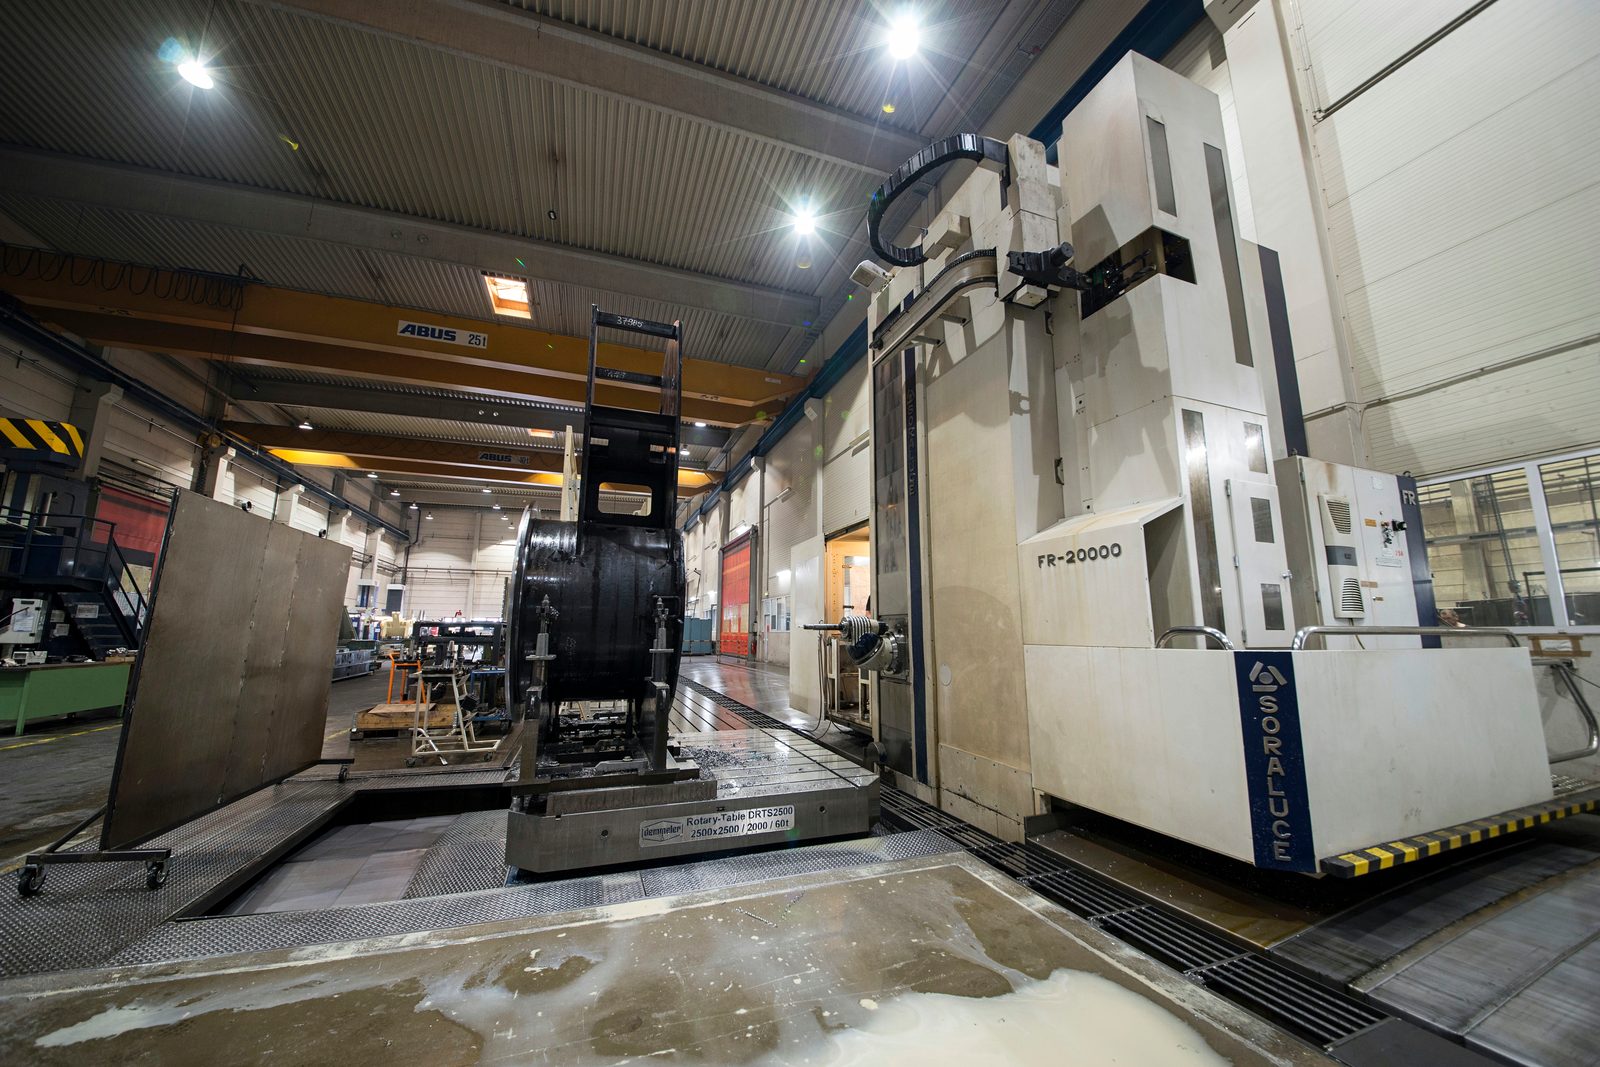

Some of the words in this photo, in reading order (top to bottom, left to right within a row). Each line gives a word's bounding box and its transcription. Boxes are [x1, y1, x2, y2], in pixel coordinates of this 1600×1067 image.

[400, 323, 457, 342] ABUS
[480, 453, 512, 462] ABUS
[1402, 489, 1416, 505] FR
[1038, 542, 1122, 569] FR-20000
[1259, 695, 1292, 861] SORALUCE
[686, 811, 746, 827] Rotary-Table
[748, 806, 793, 819] DRTS2500
[691, 825, 739, 838] 2500x2500
[747, 821, 768, 832] 2000
[775, 818, 789, 829] 60t
